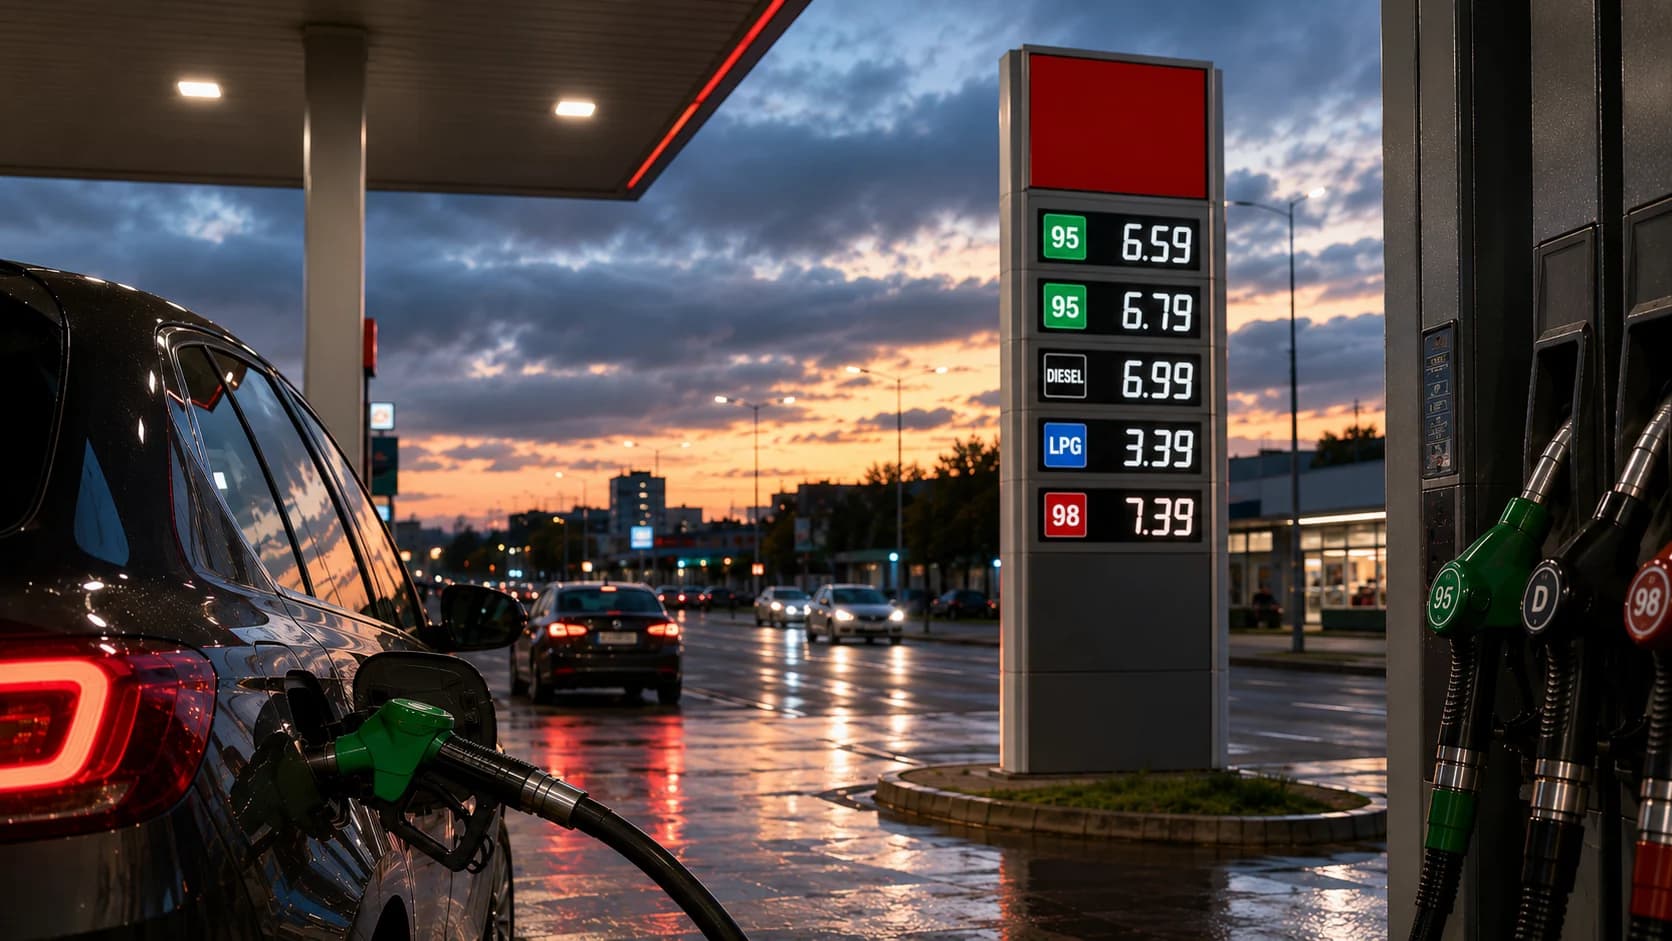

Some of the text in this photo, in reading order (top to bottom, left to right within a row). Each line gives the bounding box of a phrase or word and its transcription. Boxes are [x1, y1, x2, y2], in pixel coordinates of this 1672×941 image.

[1051, 223, 1193, 264] 95 6.59
[1051, 291, 1193, 332] 95 6.79
[1046, 359, 1194, 400] DIESEL 6.99
[1049, 428, 1194, 468] LPG 3.39
[1052, 497, 1195, 536] 98 7.39
[1433, 586, 1454, 610] 95
[1531, 585, 1549, 613] D
[1633, 587, 1662, 617] 98
